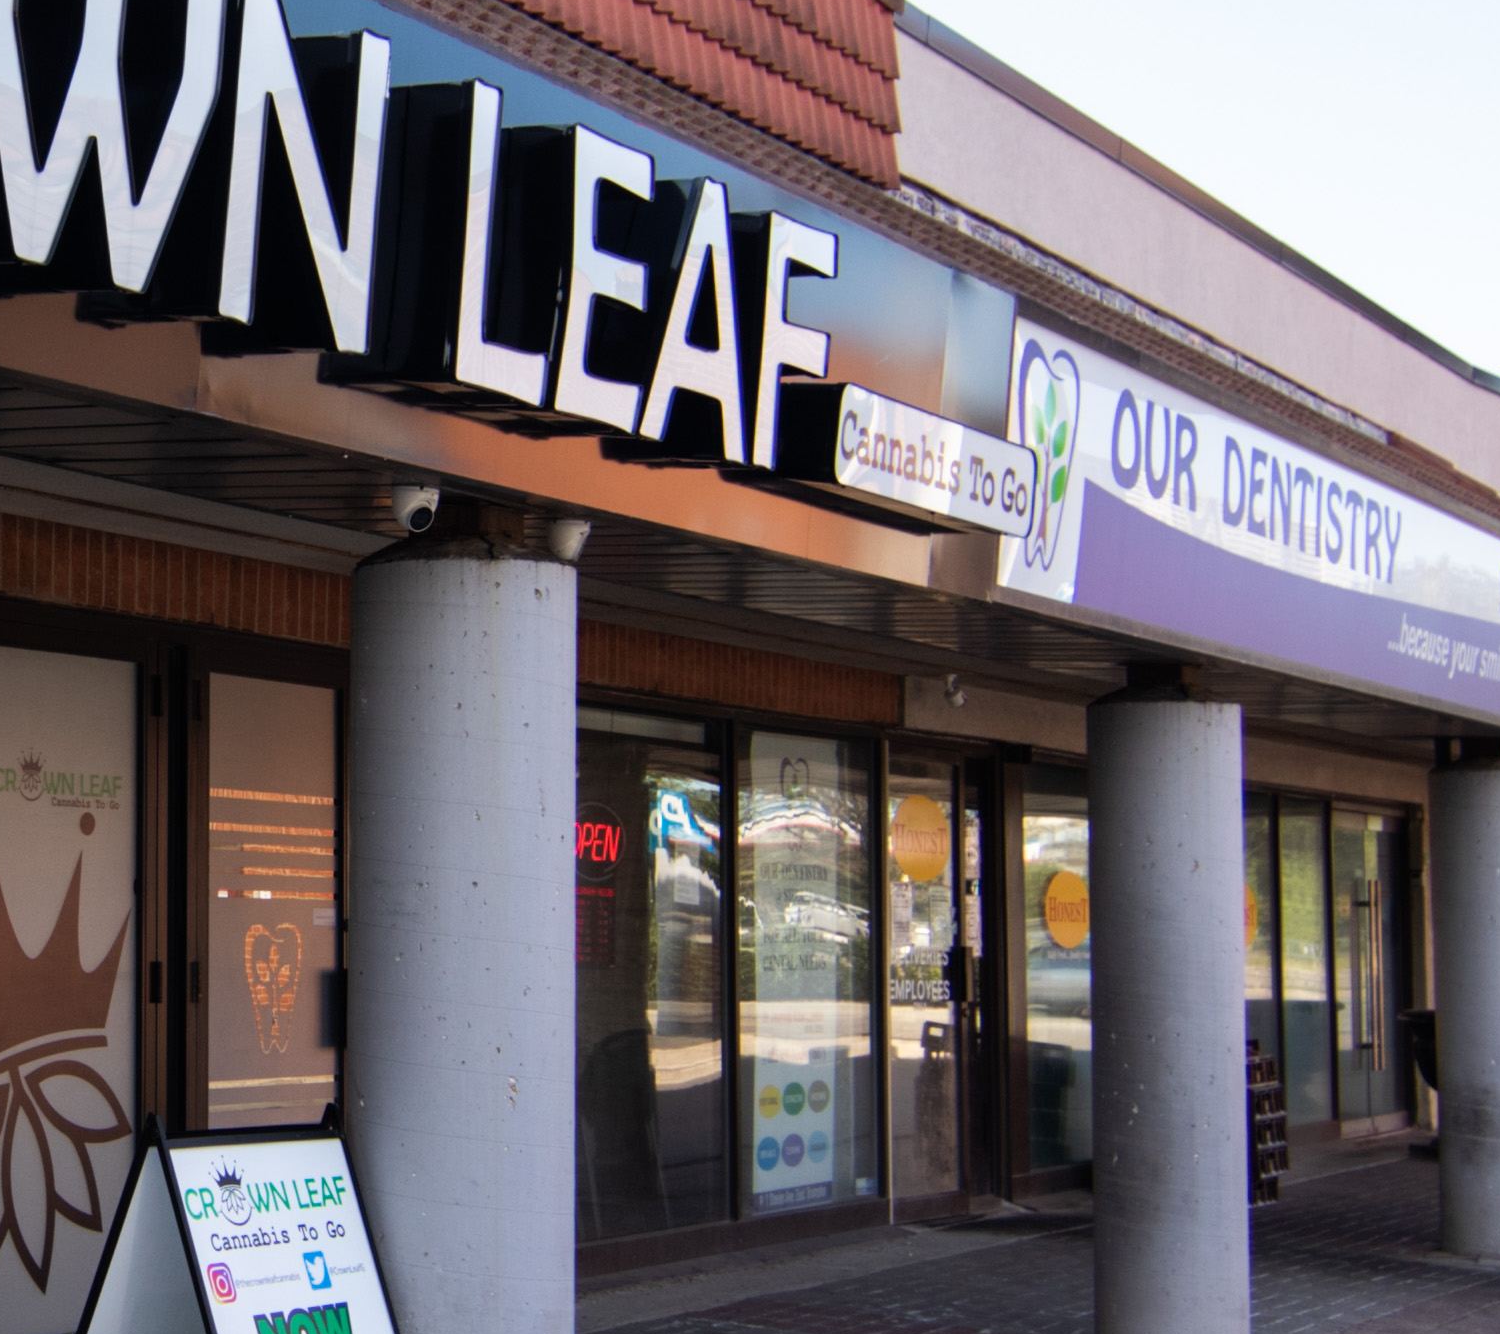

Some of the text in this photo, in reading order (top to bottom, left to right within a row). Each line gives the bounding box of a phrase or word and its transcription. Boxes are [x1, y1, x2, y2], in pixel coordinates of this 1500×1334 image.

[456, 78, 838, 470] LEAF
[841, 410, 1027, 517] Cannabis To Go
[1111, 388, 1402, 584] OUR DENTISTRY
[1449, 639, 1480, 680] your
[80, 774, 123, 798] LEAF
[51, 797, 120, 810] Cannabis To Go
[1049, 897, 1088, 923] HONEST
[890, 979, 950, 1000] EMPLOYEES
[292, 1175, 347, 1209] LEAF
[210, 1220, 346, 1252] Cannabis To Go
